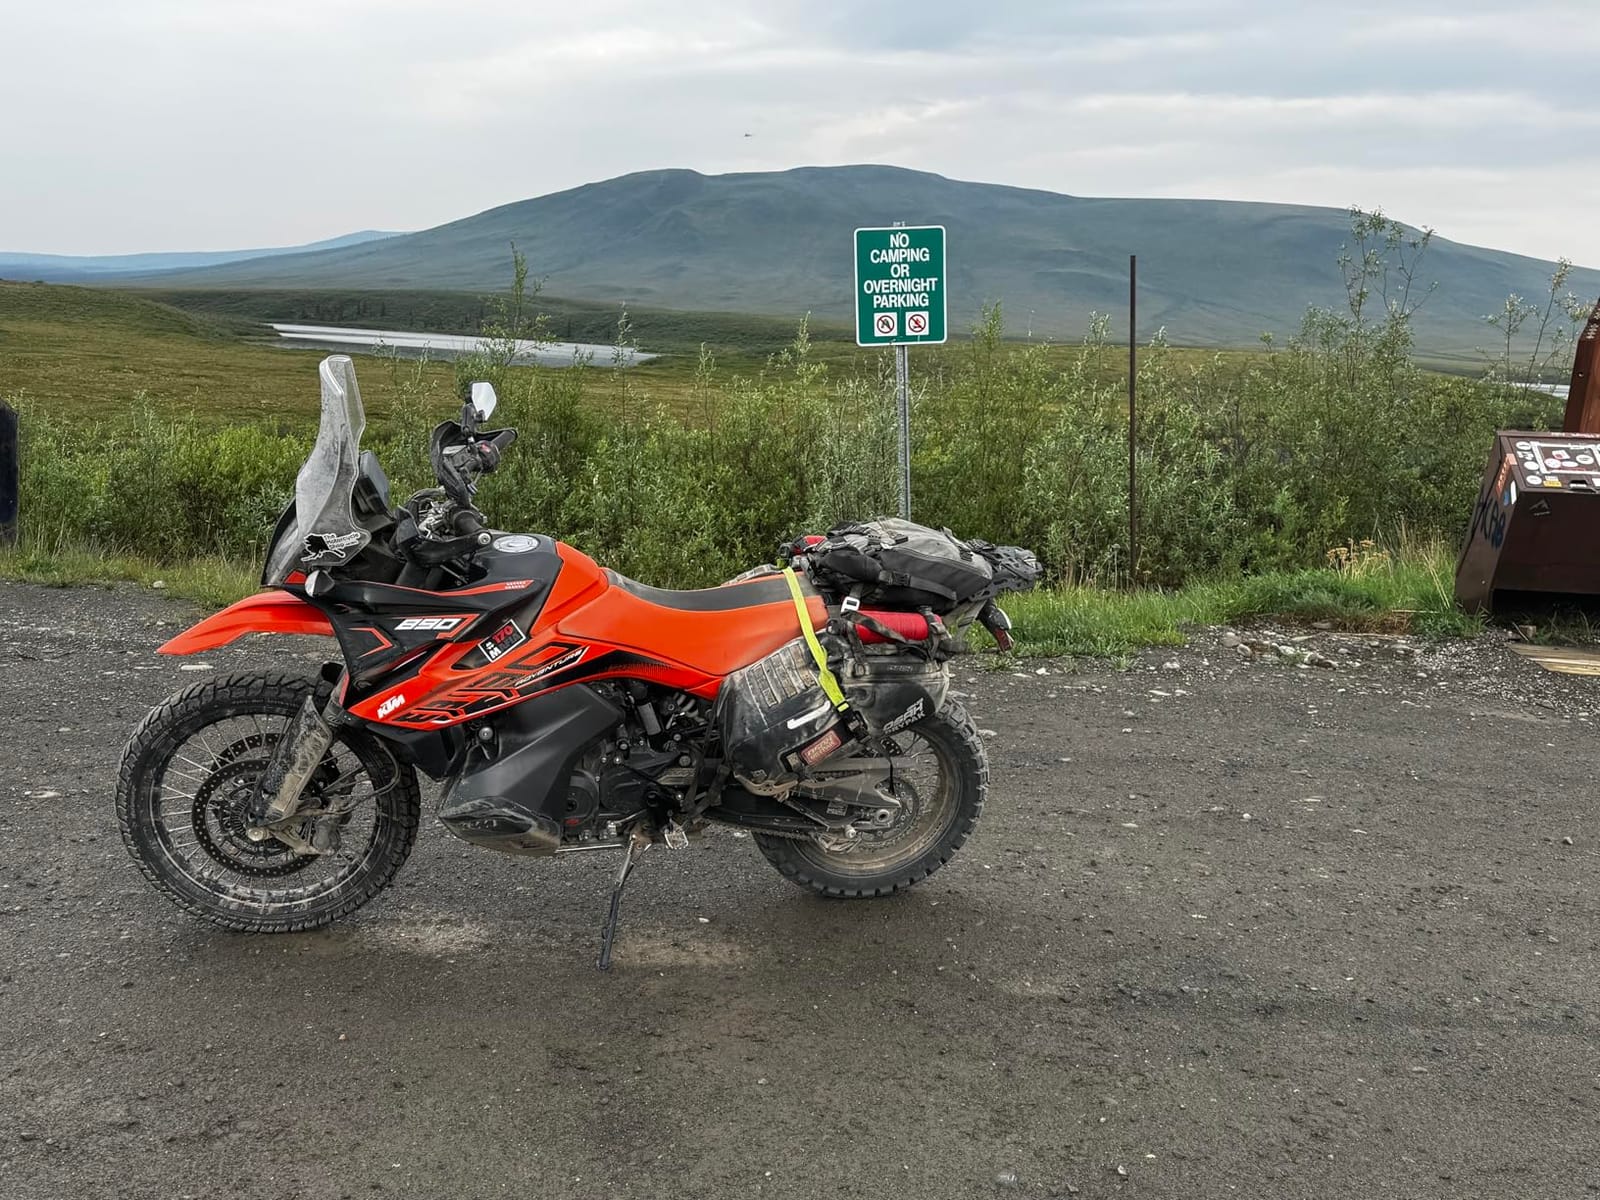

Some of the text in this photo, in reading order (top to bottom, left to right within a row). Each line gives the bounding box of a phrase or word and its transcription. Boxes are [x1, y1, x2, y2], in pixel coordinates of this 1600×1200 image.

[890, 233, 909, 248] NO
[870, 248, 930, 263] CAMPING
[890, 264, 910, 278] OR
[864, 278, 938, 294] OVERNIGHT
[873, 293, 929, 308] PARKING
[394, 618, 462, 631] 890
[492, 625, 513, 643] 170
[515, 650, 583, 686] ADVENTURE
[377, 694, 405, 719] KTM
